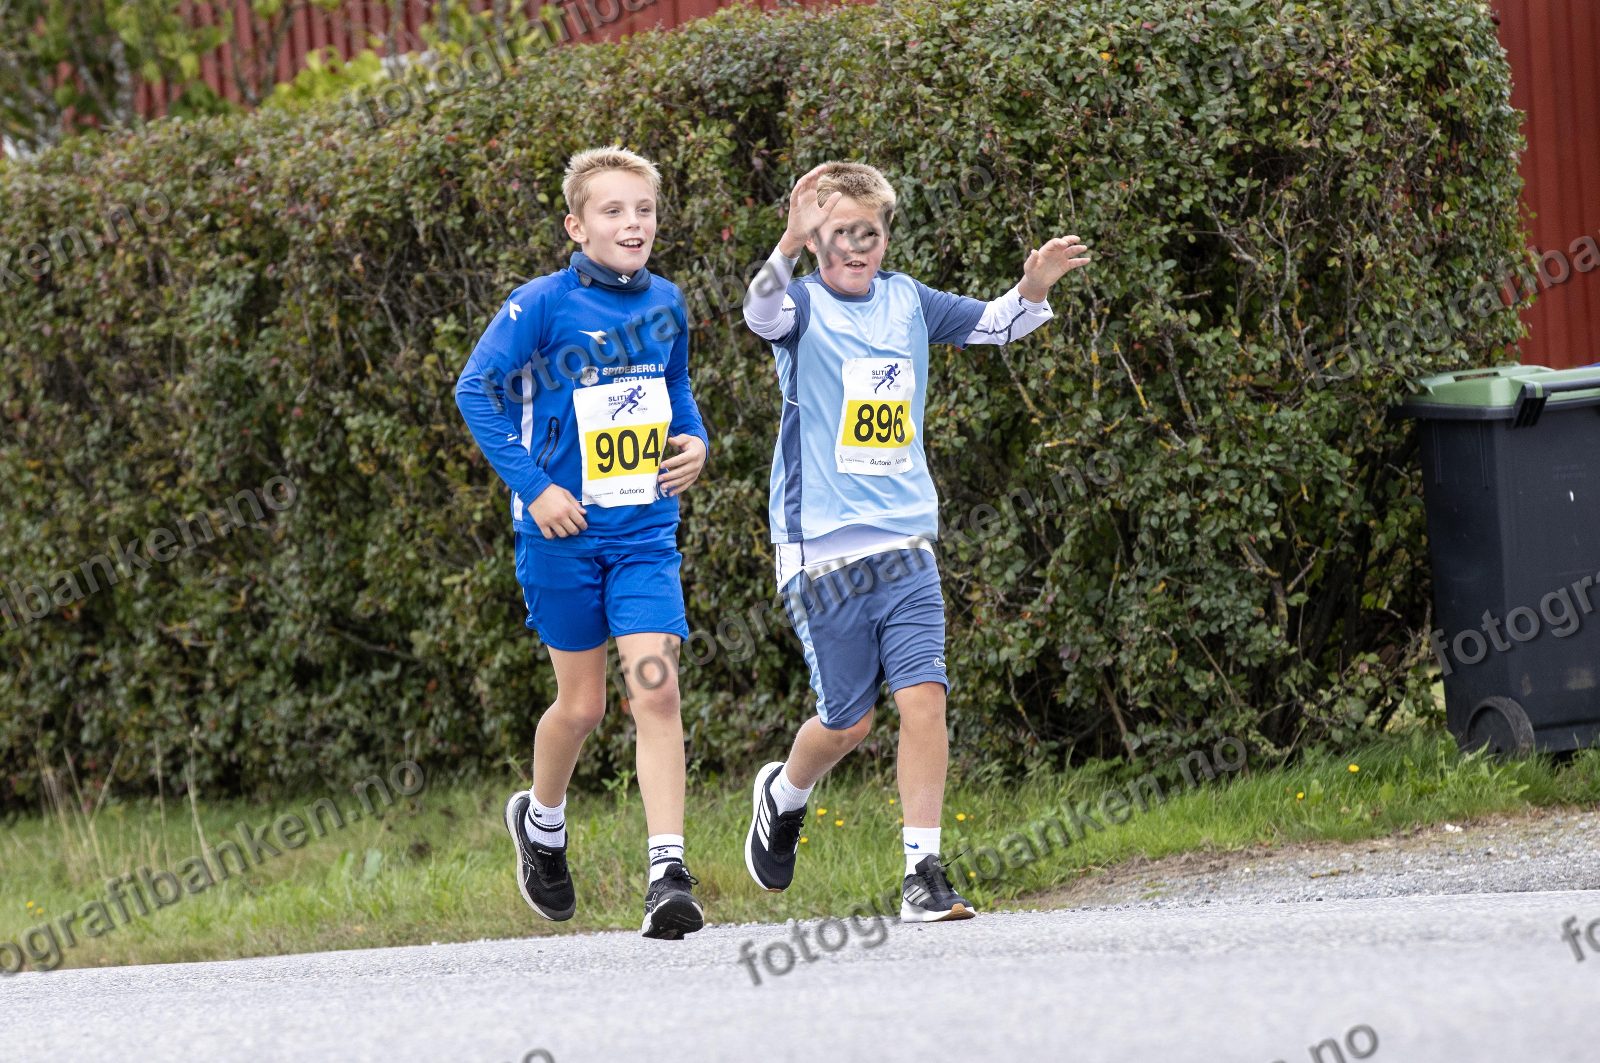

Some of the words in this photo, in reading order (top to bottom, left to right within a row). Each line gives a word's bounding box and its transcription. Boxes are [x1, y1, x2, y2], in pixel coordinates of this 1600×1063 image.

[602, 364, 656, 375] SPYDEBERG
[854, 403, 905, 443] 896
[595, 428, 660, 473] 904
